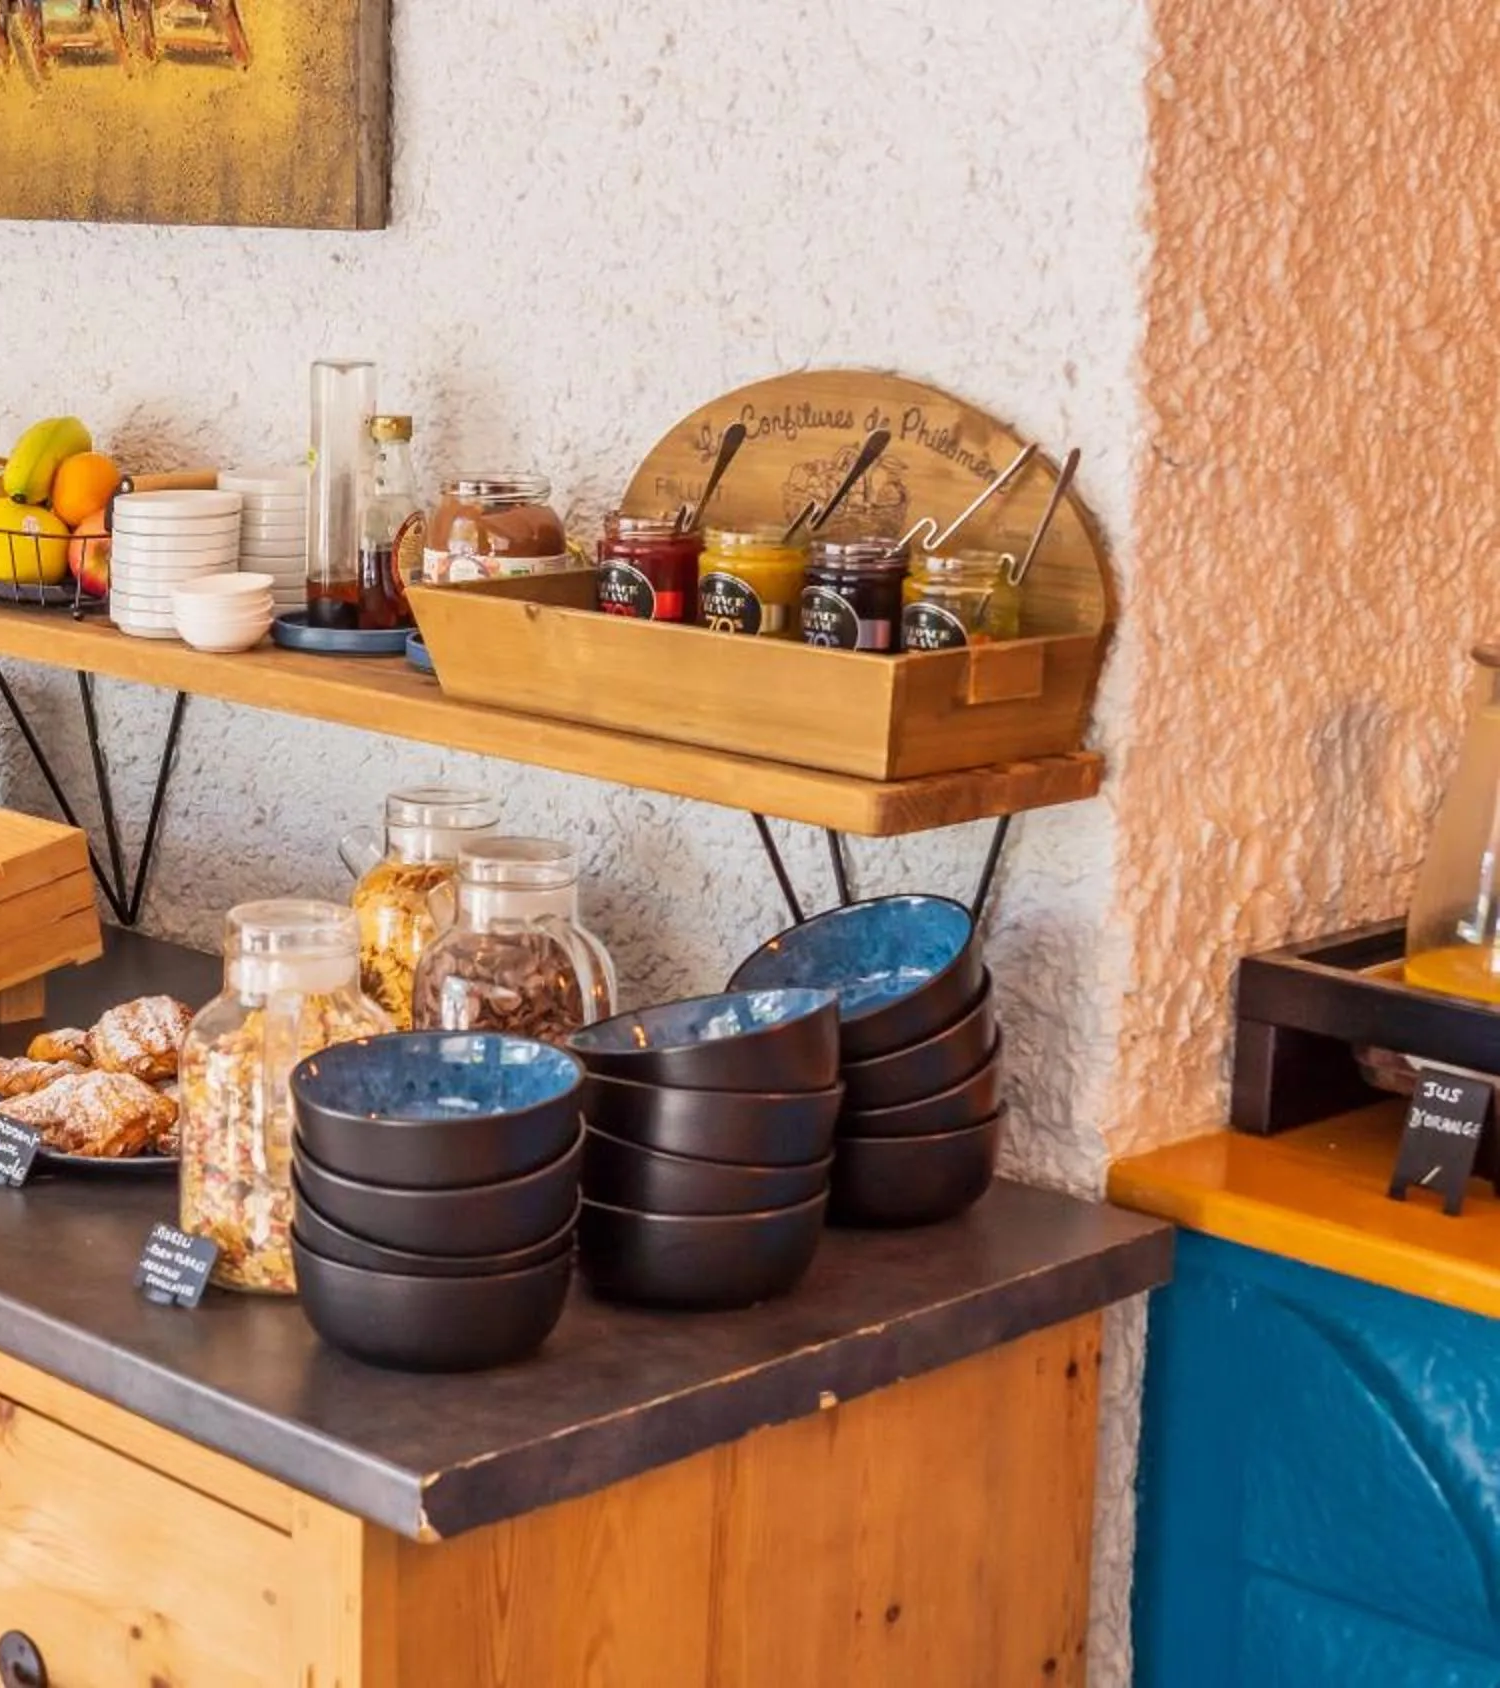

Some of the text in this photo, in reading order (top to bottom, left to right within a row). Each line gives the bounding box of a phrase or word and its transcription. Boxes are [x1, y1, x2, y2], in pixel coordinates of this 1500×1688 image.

[740, 403, 854, 441] Confitures
[864, 405, 891, 431] de
[1422, 1080, 1464, 1103] JUS
[1408, 1106, 1483, 1139] D'ORANGE
